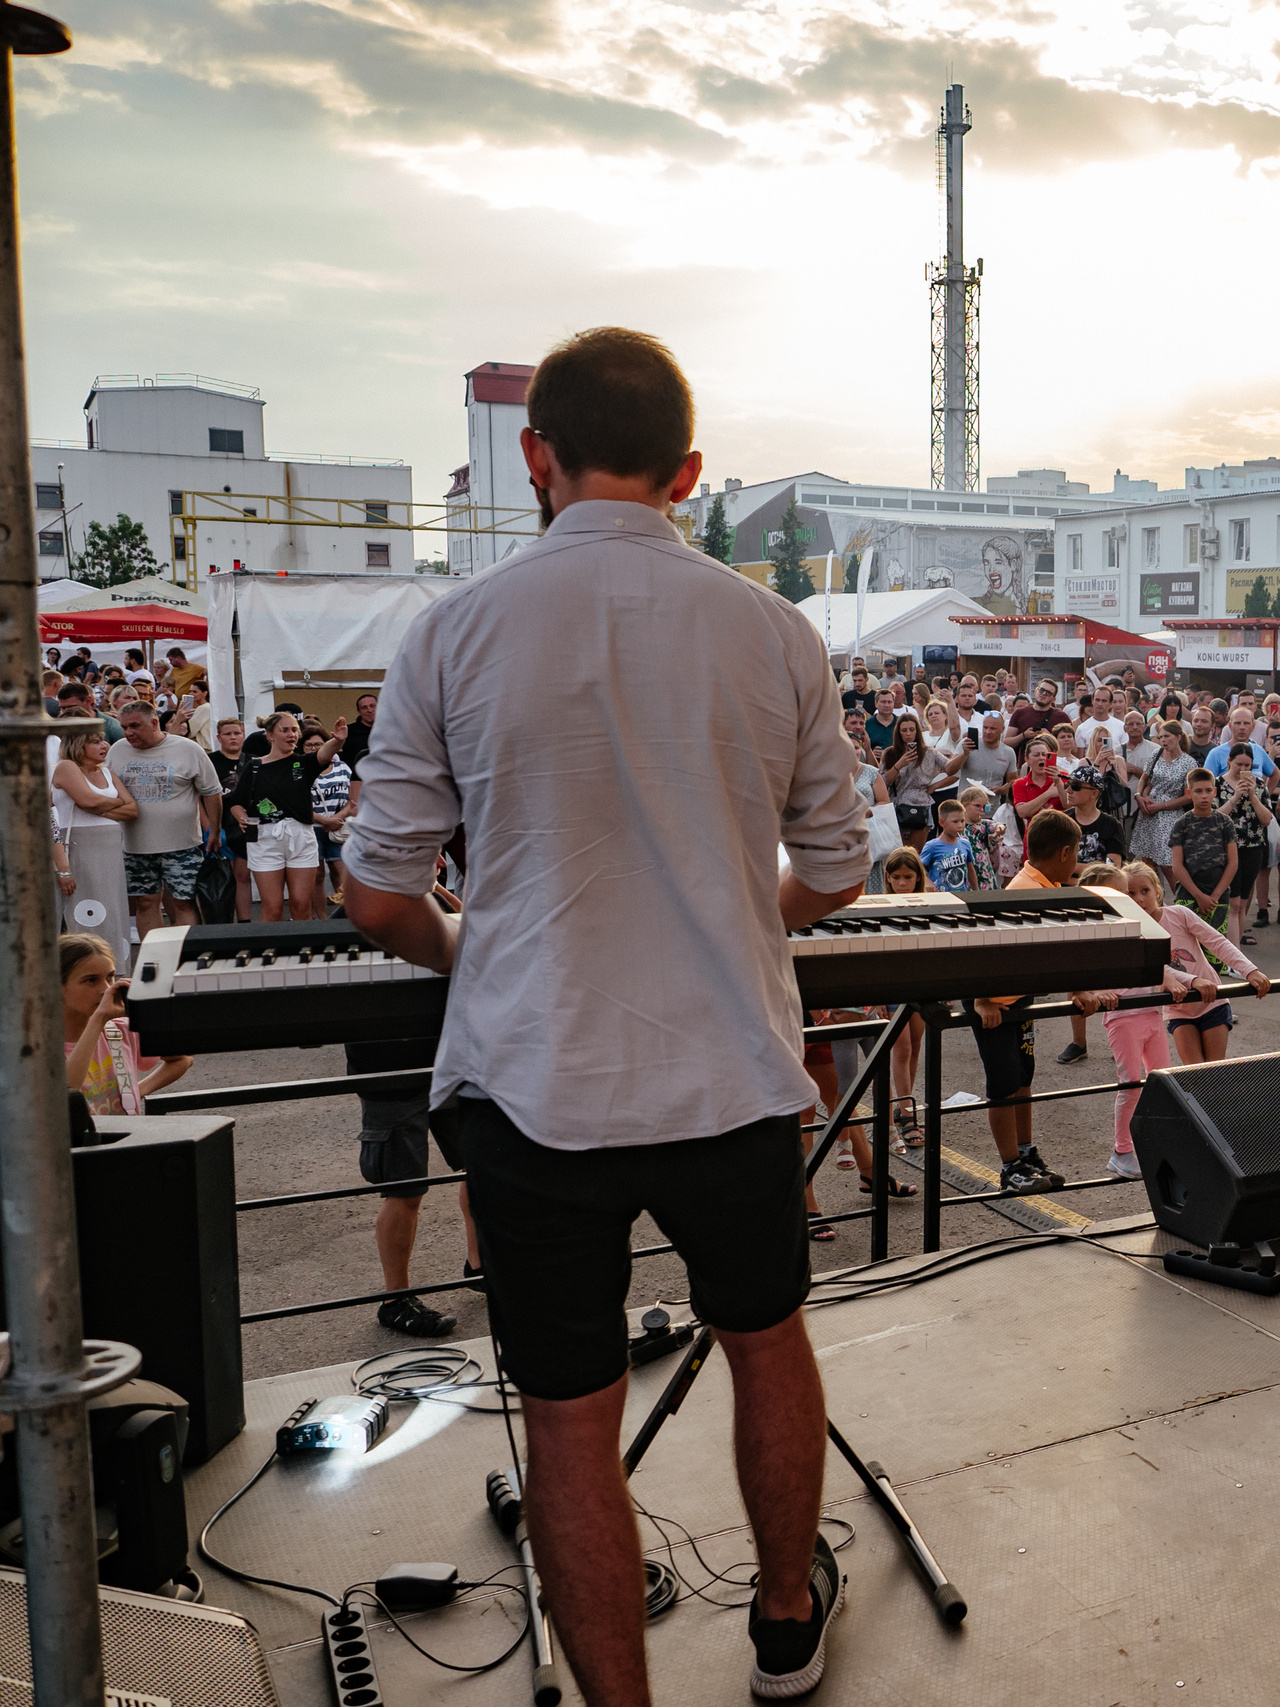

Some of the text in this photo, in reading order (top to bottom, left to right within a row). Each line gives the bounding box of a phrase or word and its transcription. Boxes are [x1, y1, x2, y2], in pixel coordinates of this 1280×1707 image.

[1067, 578, 1117, 592] СтеклоМастер
[1171, 581, 1193, 592] МАГАЗИН
[111, 593, 191, 607] PRIMATOR
[1168, 595, 1195, 606] КУЛИНАРИЯ
[984, 643, 1003, 651] MARINO
[1040, 644, 1060, 652] ПЯН-СЕ
[1148, 655, 1169, 666] ПЯН
[1197, 652, 1250, 663] KONIG WURST
